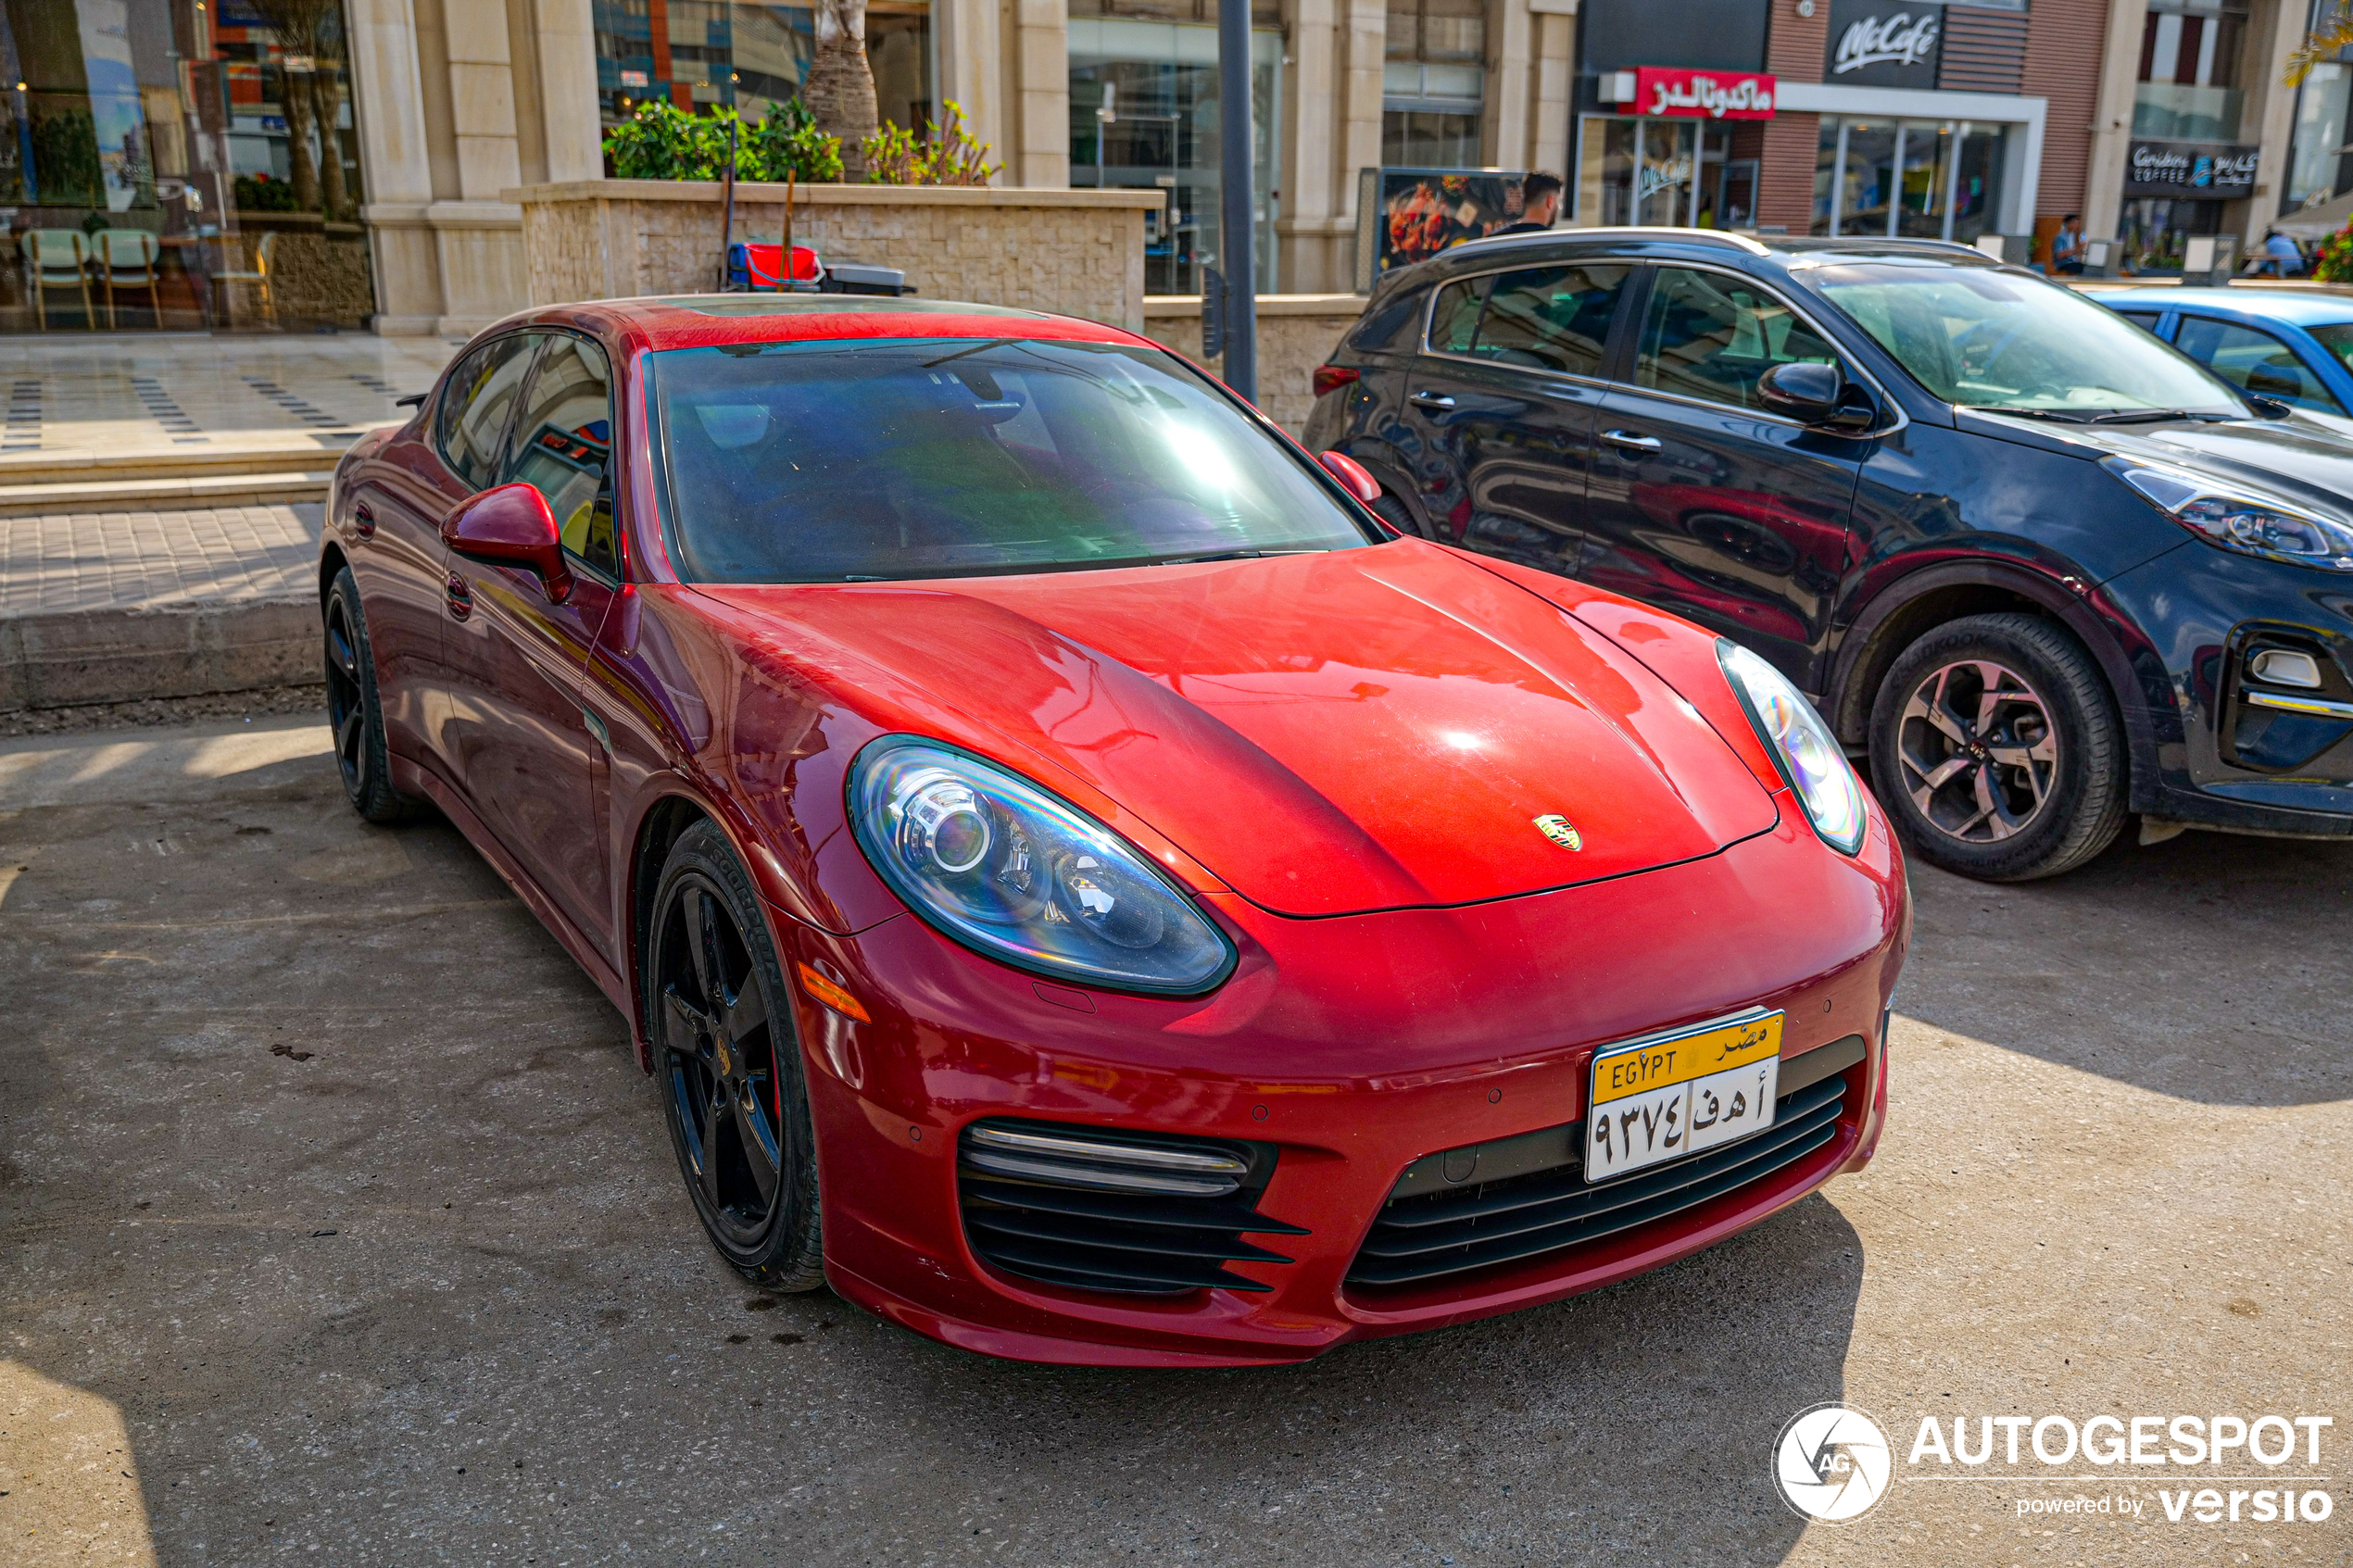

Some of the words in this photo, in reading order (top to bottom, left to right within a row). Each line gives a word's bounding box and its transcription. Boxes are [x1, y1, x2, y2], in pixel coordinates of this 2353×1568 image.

[1834, 11, 1940, 70] McCafé
[1648, 75, 1773, 119] ماكدونالدز
[2133, 167, 2186, 184] COFFEE
[1715, 1027, 1768, 1061] مصر
[1611, 1050, 1678, 1089] EGYPT
